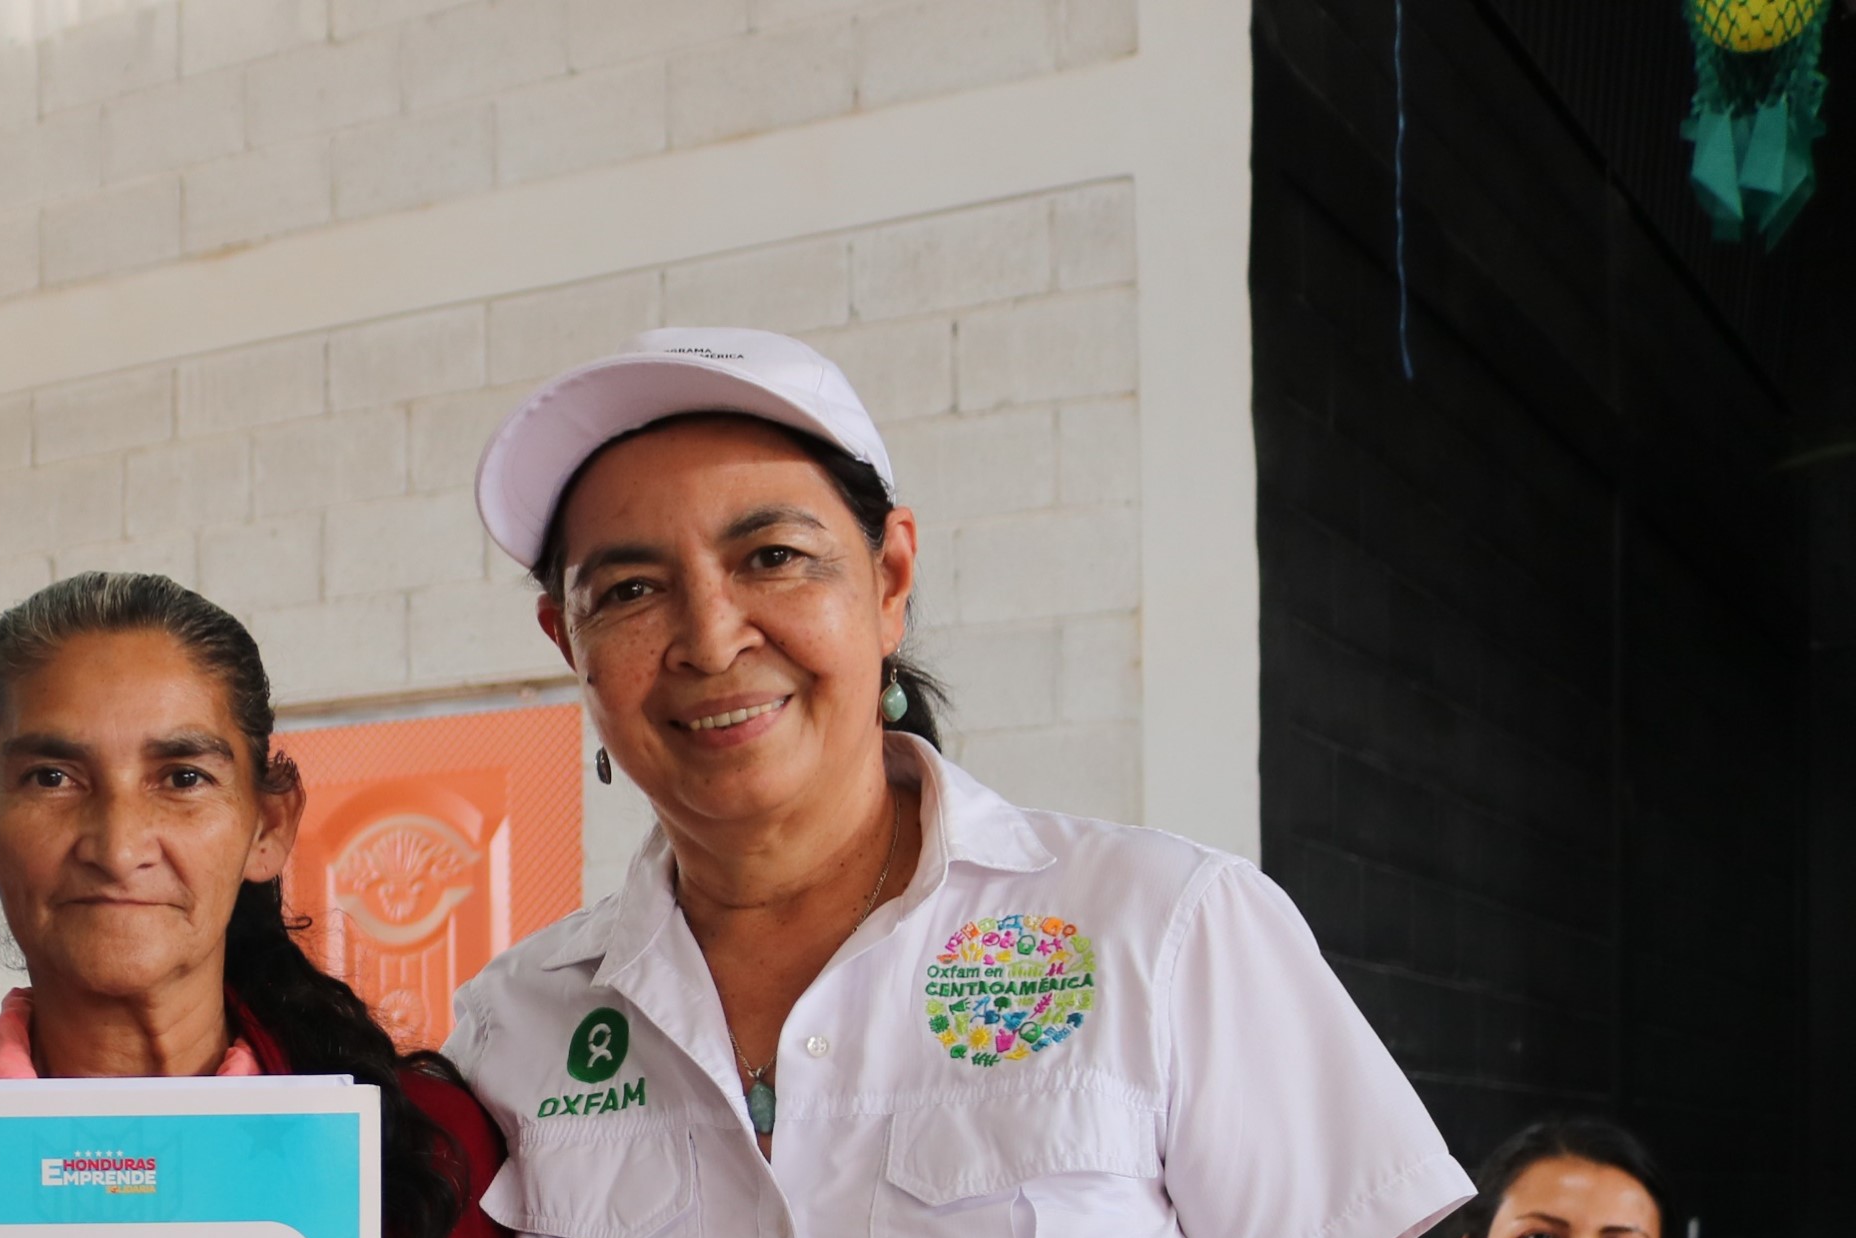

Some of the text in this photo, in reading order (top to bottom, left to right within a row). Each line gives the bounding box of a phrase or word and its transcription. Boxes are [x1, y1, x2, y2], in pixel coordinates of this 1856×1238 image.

[927, 965, 1004, 979] Oxfam en
[537, 1076, 646, 1118] OXFAM
[41, 1158, 157, 1186] EMPRENDE
[63, 1158, 156, 1171] HONDURAS
